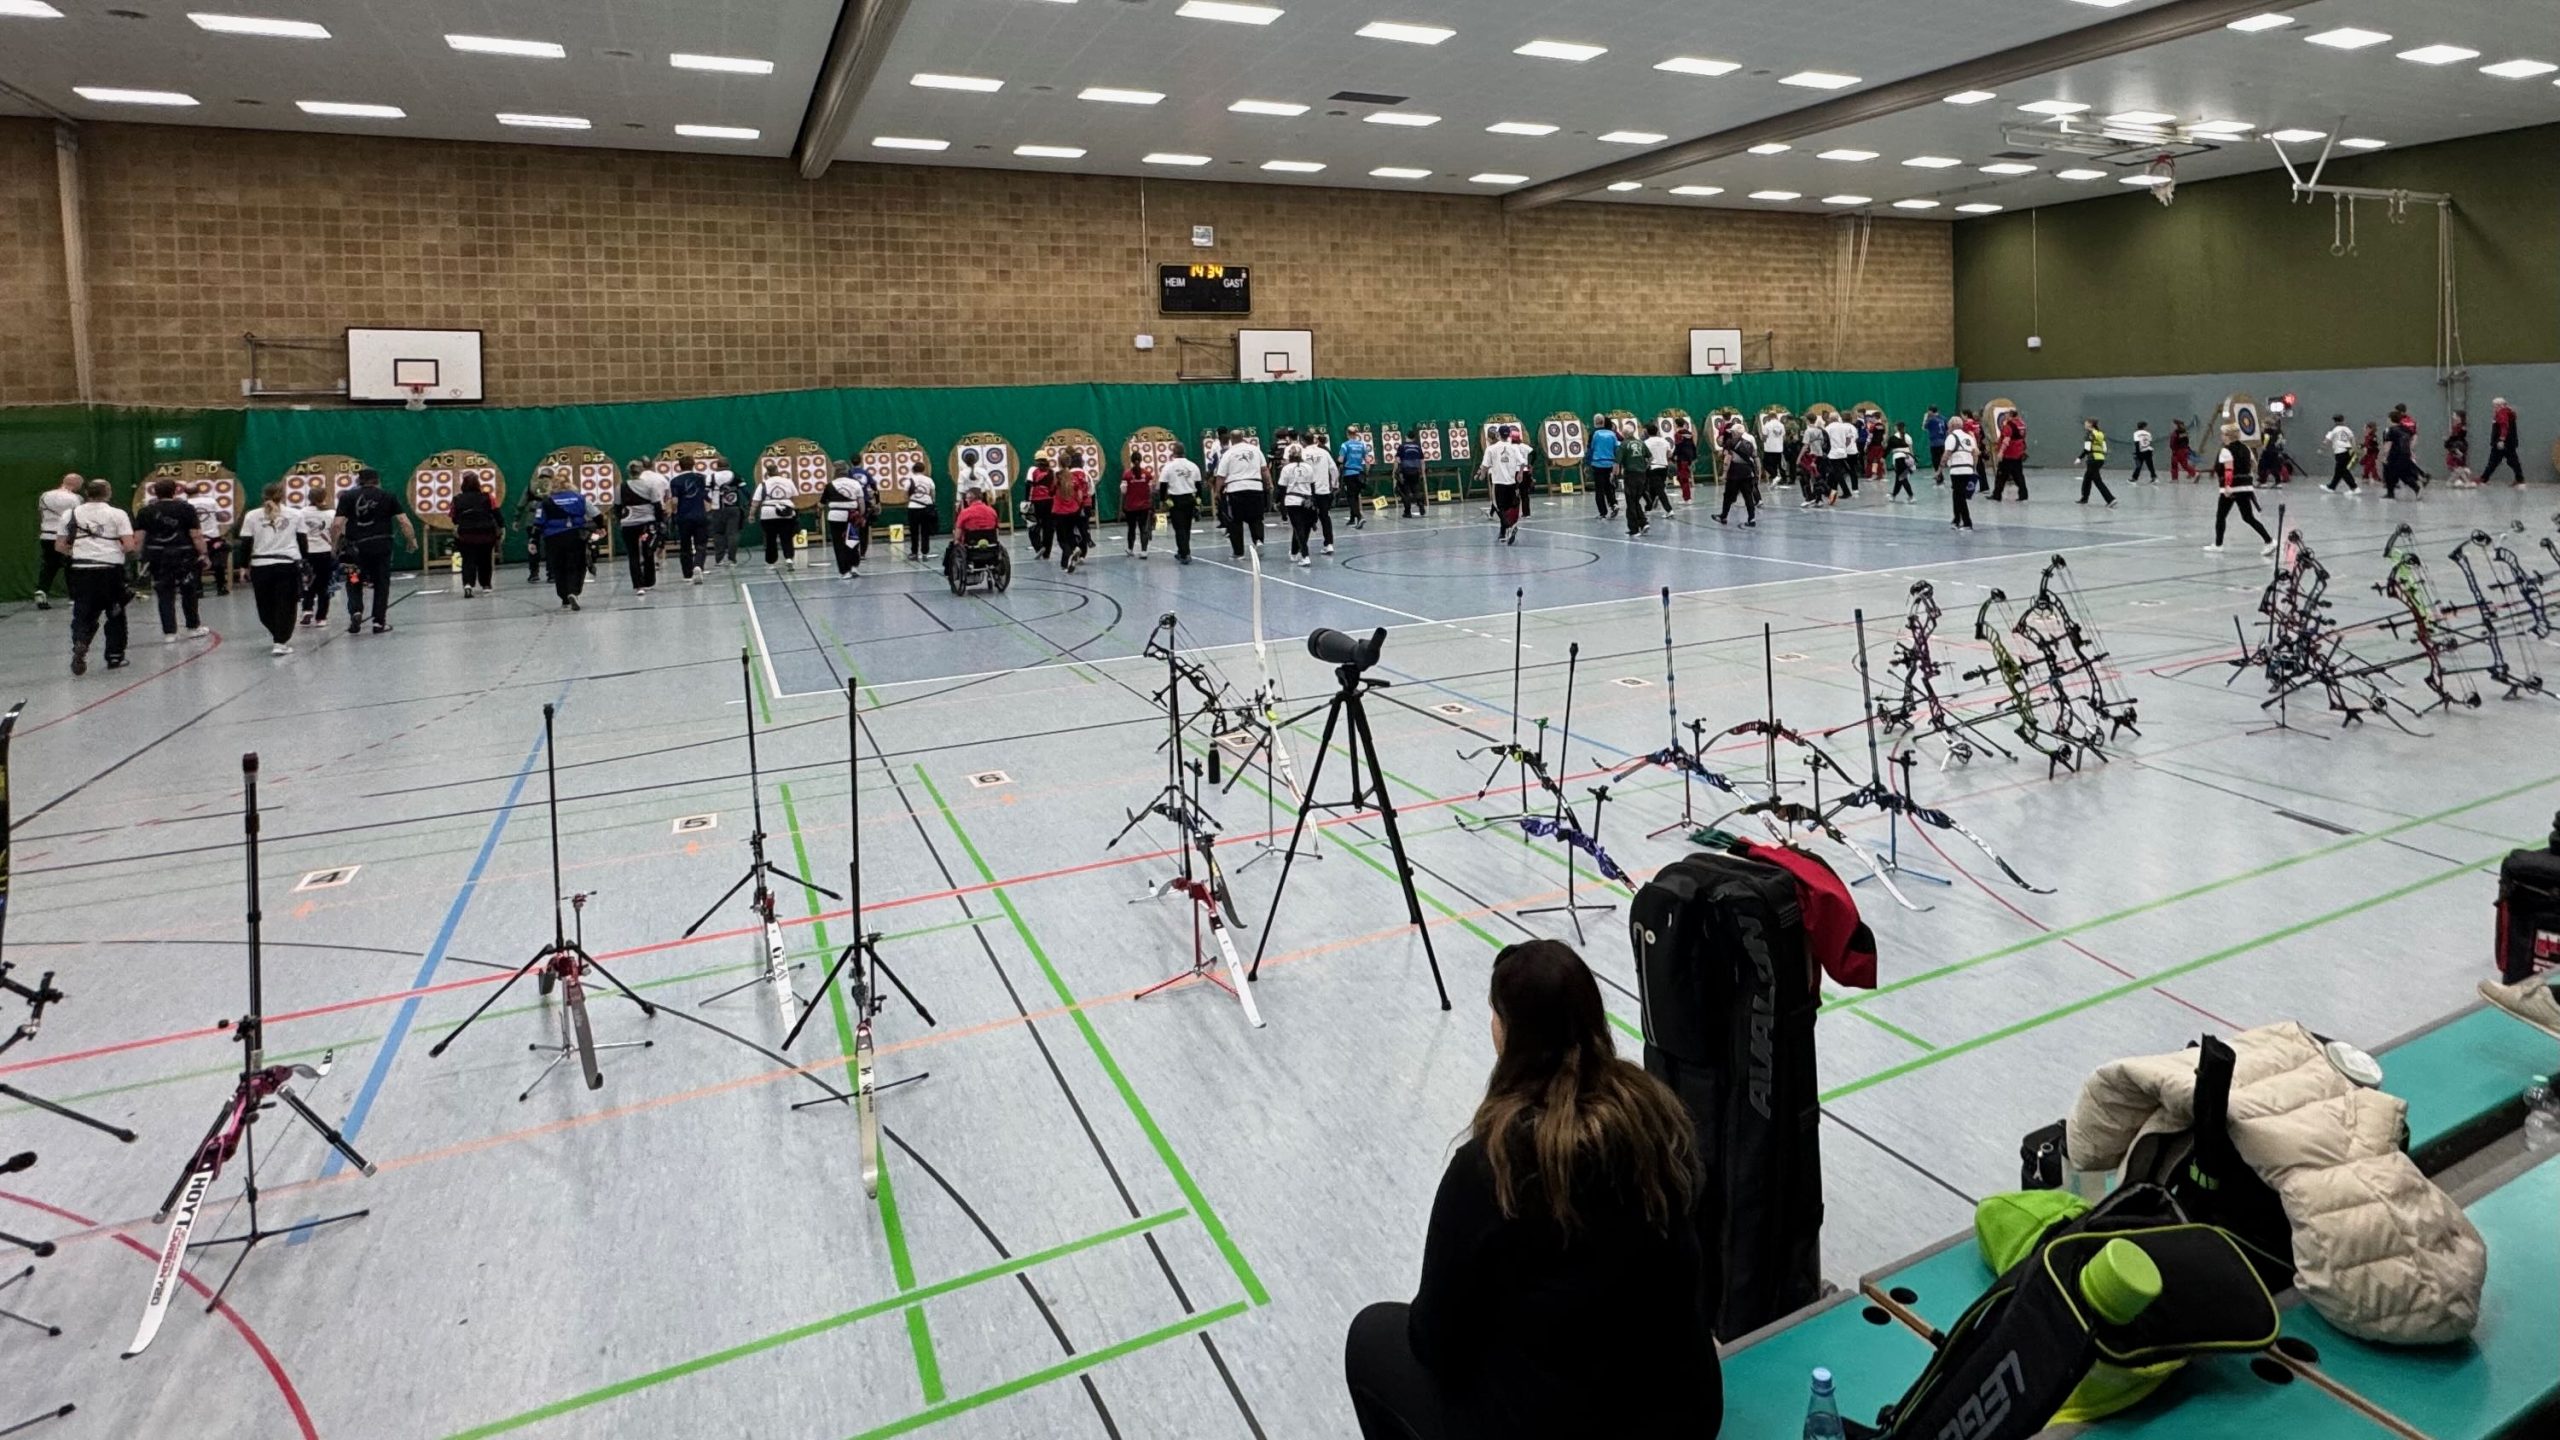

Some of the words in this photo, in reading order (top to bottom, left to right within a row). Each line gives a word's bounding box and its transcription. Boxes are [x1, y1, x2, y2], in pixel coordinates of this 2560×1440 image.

[1165, 278, 1186, 287] HEIM
[1223, 278, 1244, 288] GAST
[683, 817, 708, 828] 5
[309, 871, 341, 883] 4
[1736, 914, 1777, 1119] AVALON
[176, 1177, 208, 1230] HOYT
